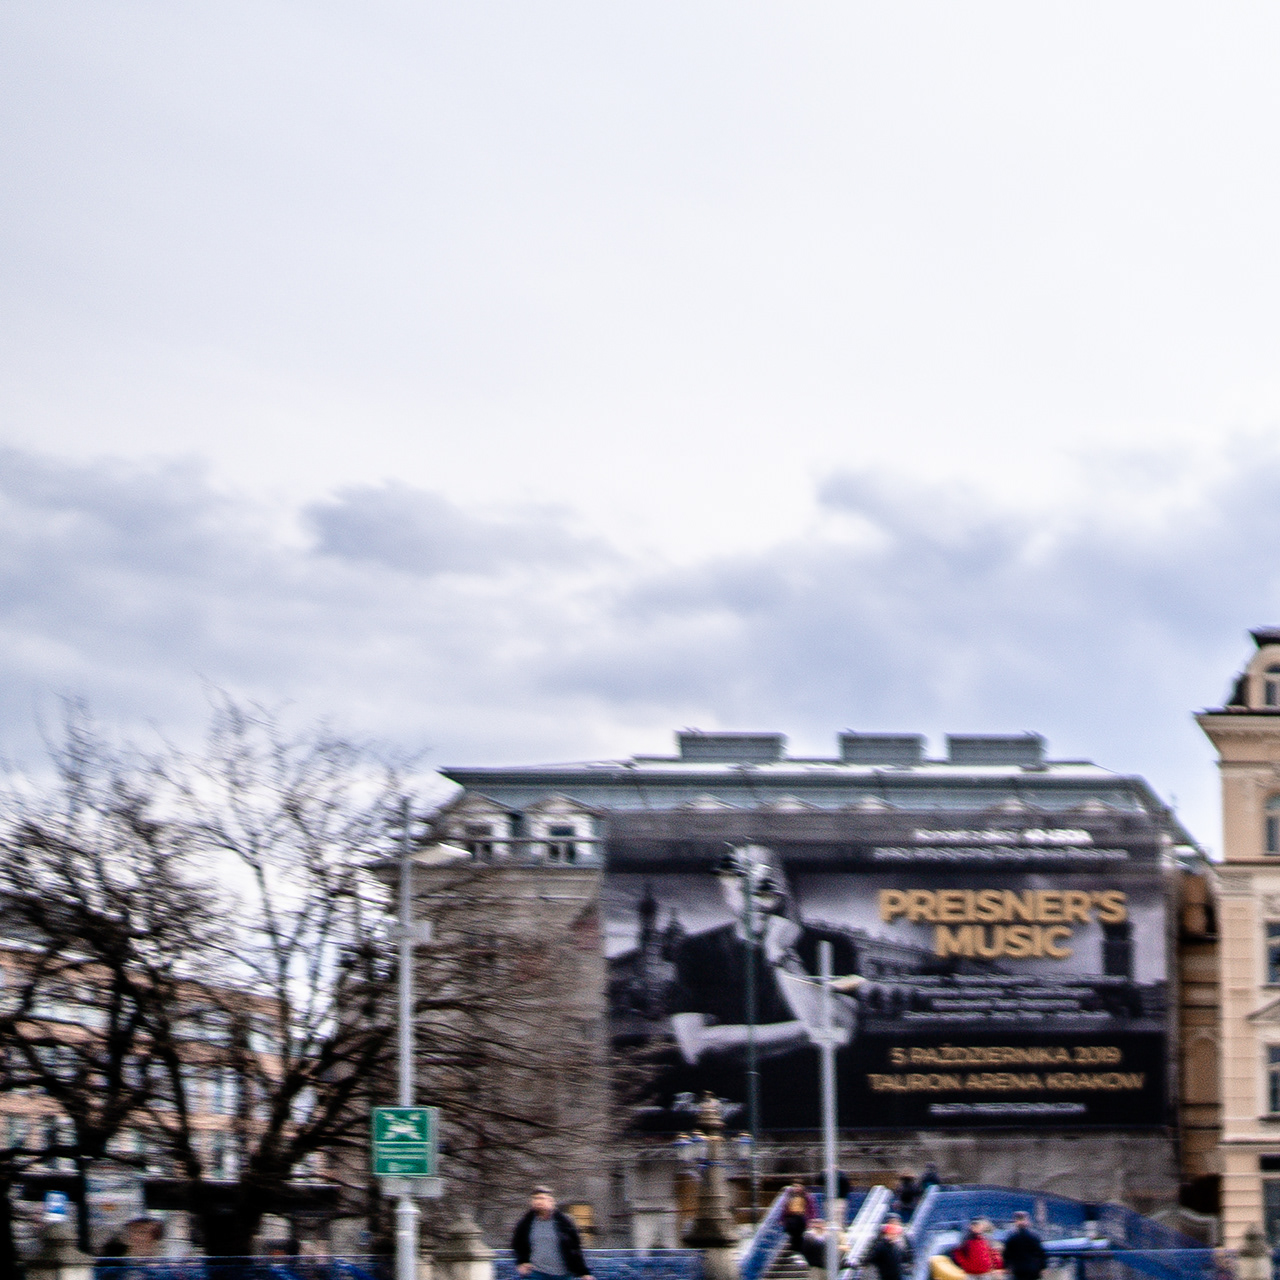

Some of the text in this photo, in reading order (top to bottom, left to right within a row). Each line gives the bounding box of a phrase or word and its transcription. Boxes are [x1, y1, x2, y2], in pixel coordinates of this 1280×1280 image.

[880, 888, 1128, 923] PREISNER'S
[934, 924, 1073, 959] MUSIC
[867, 1073, 960, 1090] TAURON
[963, 1073, 1044, 1090] ARENA
